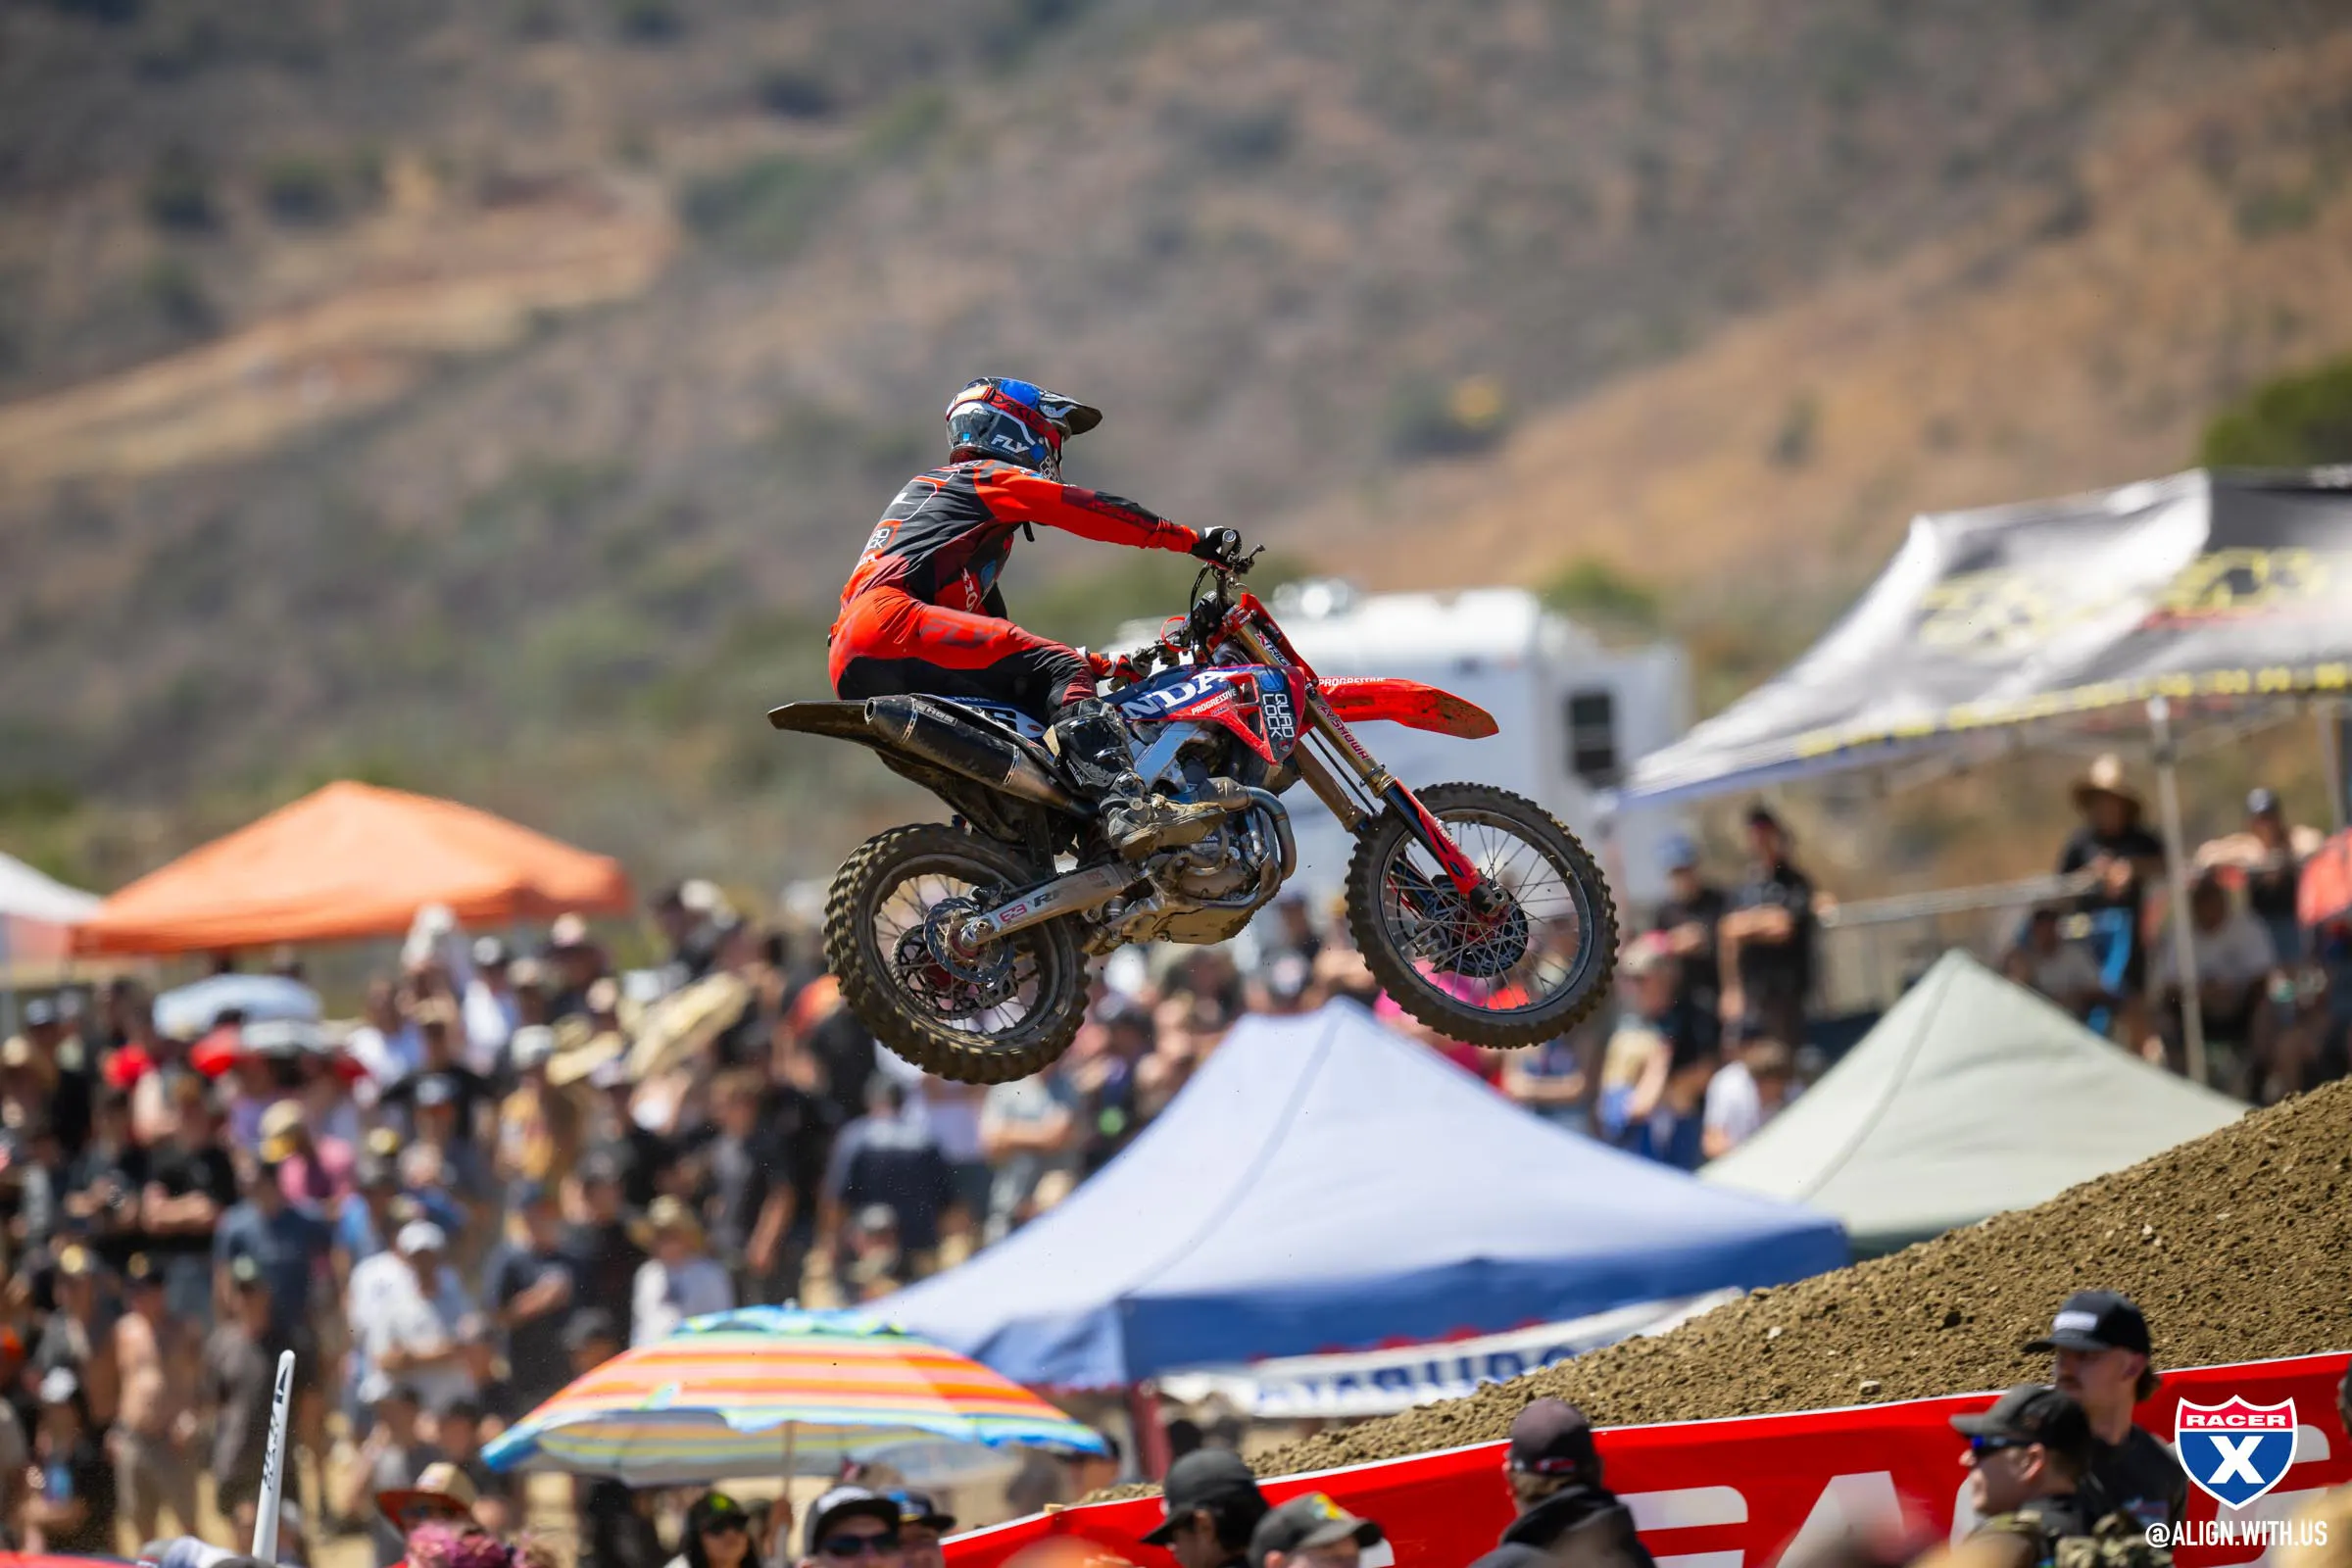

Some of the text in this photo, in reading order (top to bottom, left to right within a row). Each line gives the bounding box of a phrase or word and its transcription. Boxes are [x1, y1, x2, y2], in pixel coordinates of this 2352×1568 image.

[991, 433, 1031, 454] FLY
[1120, 670, 1239, 720] NDA
[1191, 688, 1238, 715] PROGRESSIVE
[1262, 692, 1284, 740] LOCK
[1274, 692, 1296, 739] QUAD
[1331, 716, 1371, 761] SHOWA
